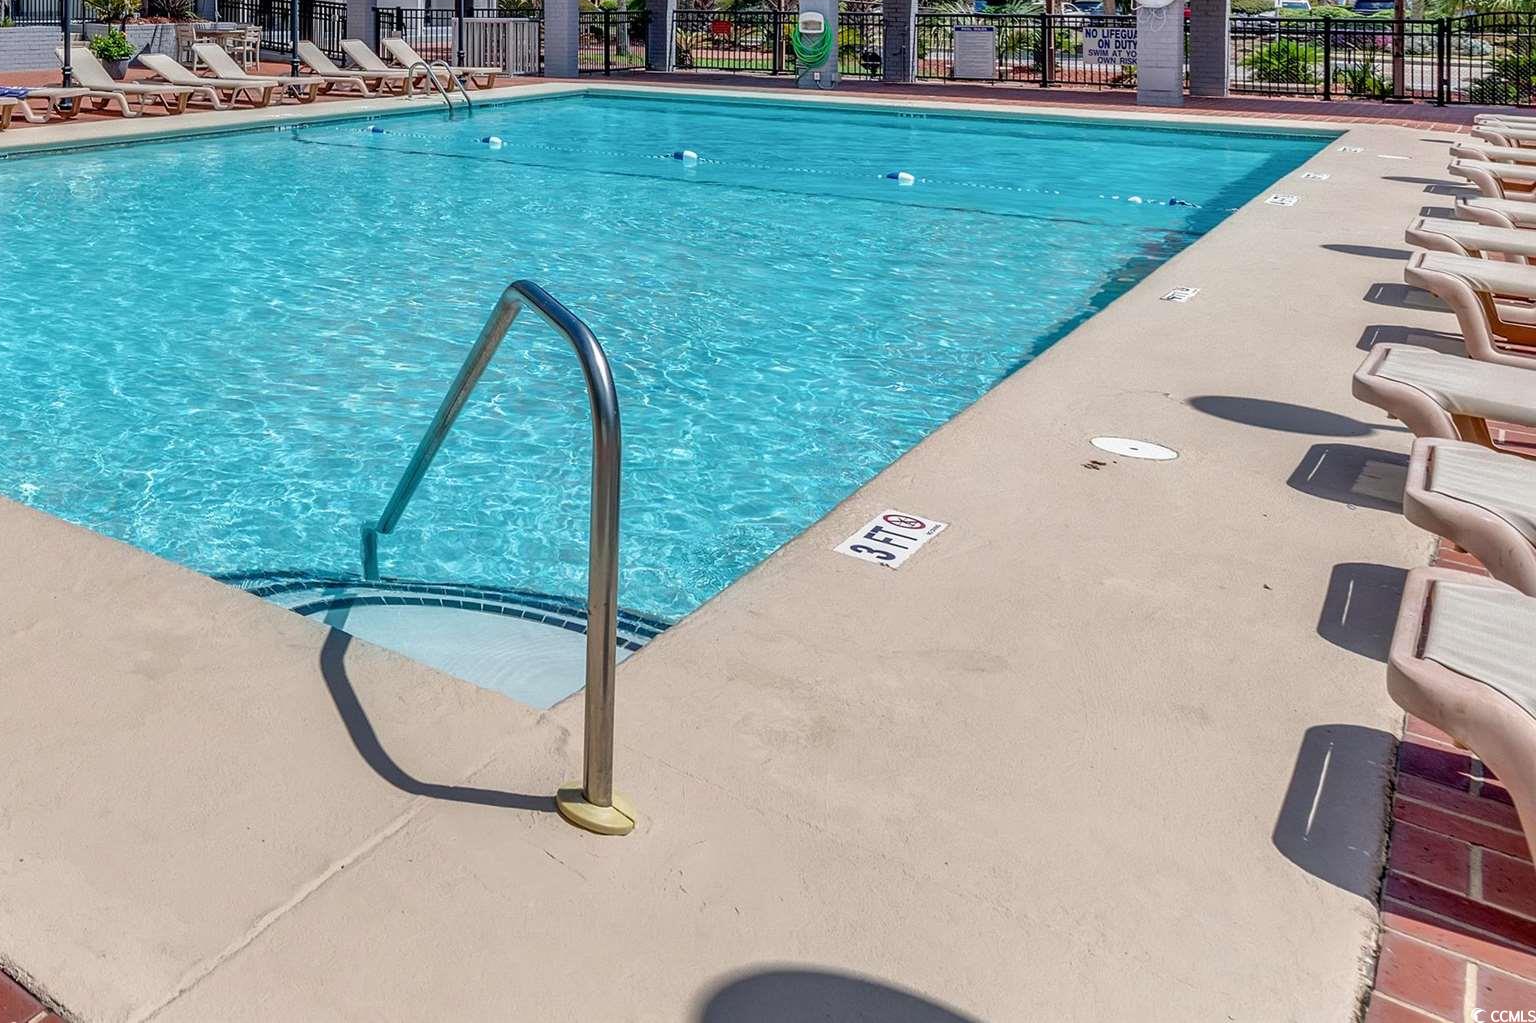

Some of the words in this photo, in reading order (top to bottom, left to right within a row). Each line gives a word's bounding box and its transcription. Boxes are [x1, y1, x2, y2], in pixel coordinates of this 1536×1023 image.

[1085, 29, 1098, 38] NO
[1098, 40, 1110, 49] ON
[1115, 40, 1137, 49] DUTY
[1119, 57, 1137, 65] RISK
[864, 525, 918, 550] FT
[850, 544, 896, 561] 3
